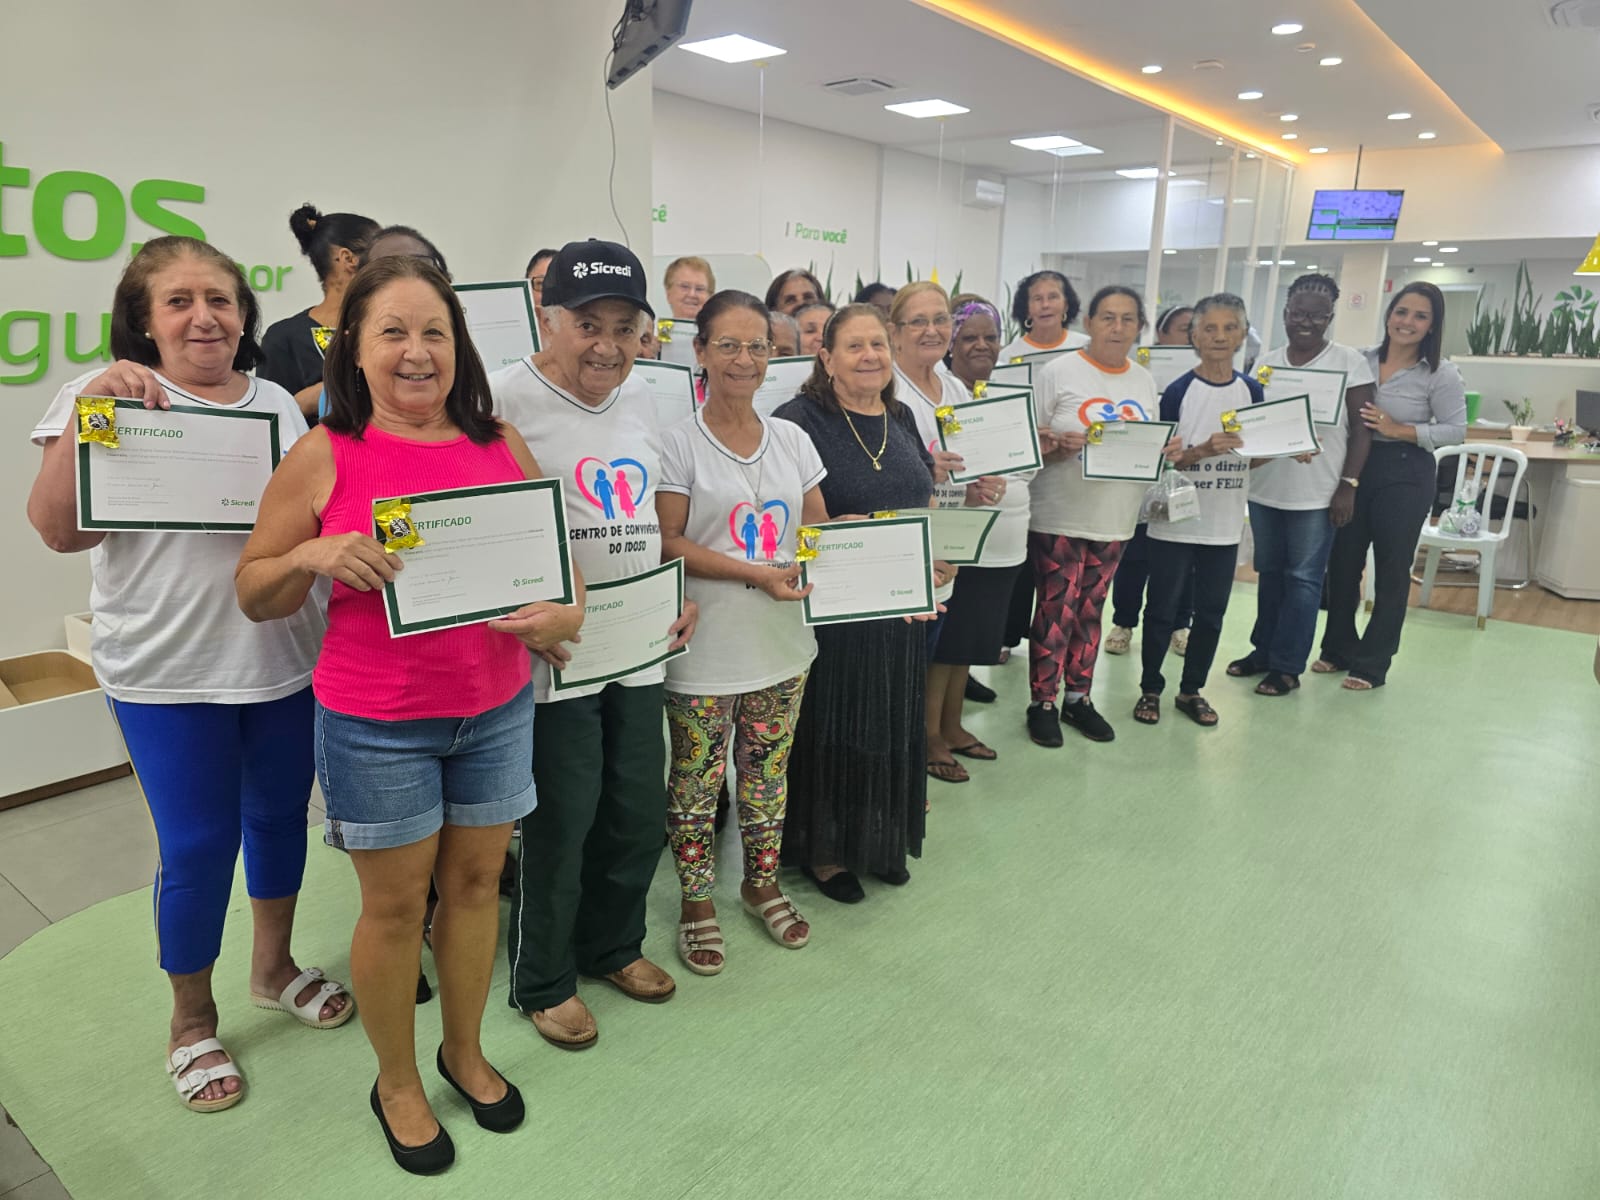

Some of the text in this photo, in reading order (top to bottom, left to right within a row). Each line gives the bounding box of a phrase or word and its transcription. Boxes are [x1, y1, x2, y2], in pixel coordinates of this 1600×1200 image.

[822, 228, 848, 244] você
[590, 262, 631, 277] Sicredi
[237, 263, 293, 293] or
[114, 426, 184, 439] ERTIFICADO
[230, 499, 255, 507] Sicredi
[412, 516, 472, 531] RTIFICADO
[569, 527, 607, 540] CENTRO
[610, 525, 622, 537] DE
[609, 540, 647, 554] DO IDOSO
[817, 542, 864, 552] CERTIFICADO
[521, 576, 544, 586] Sicredi
[584, 600, 624, 614] TIFICADO
